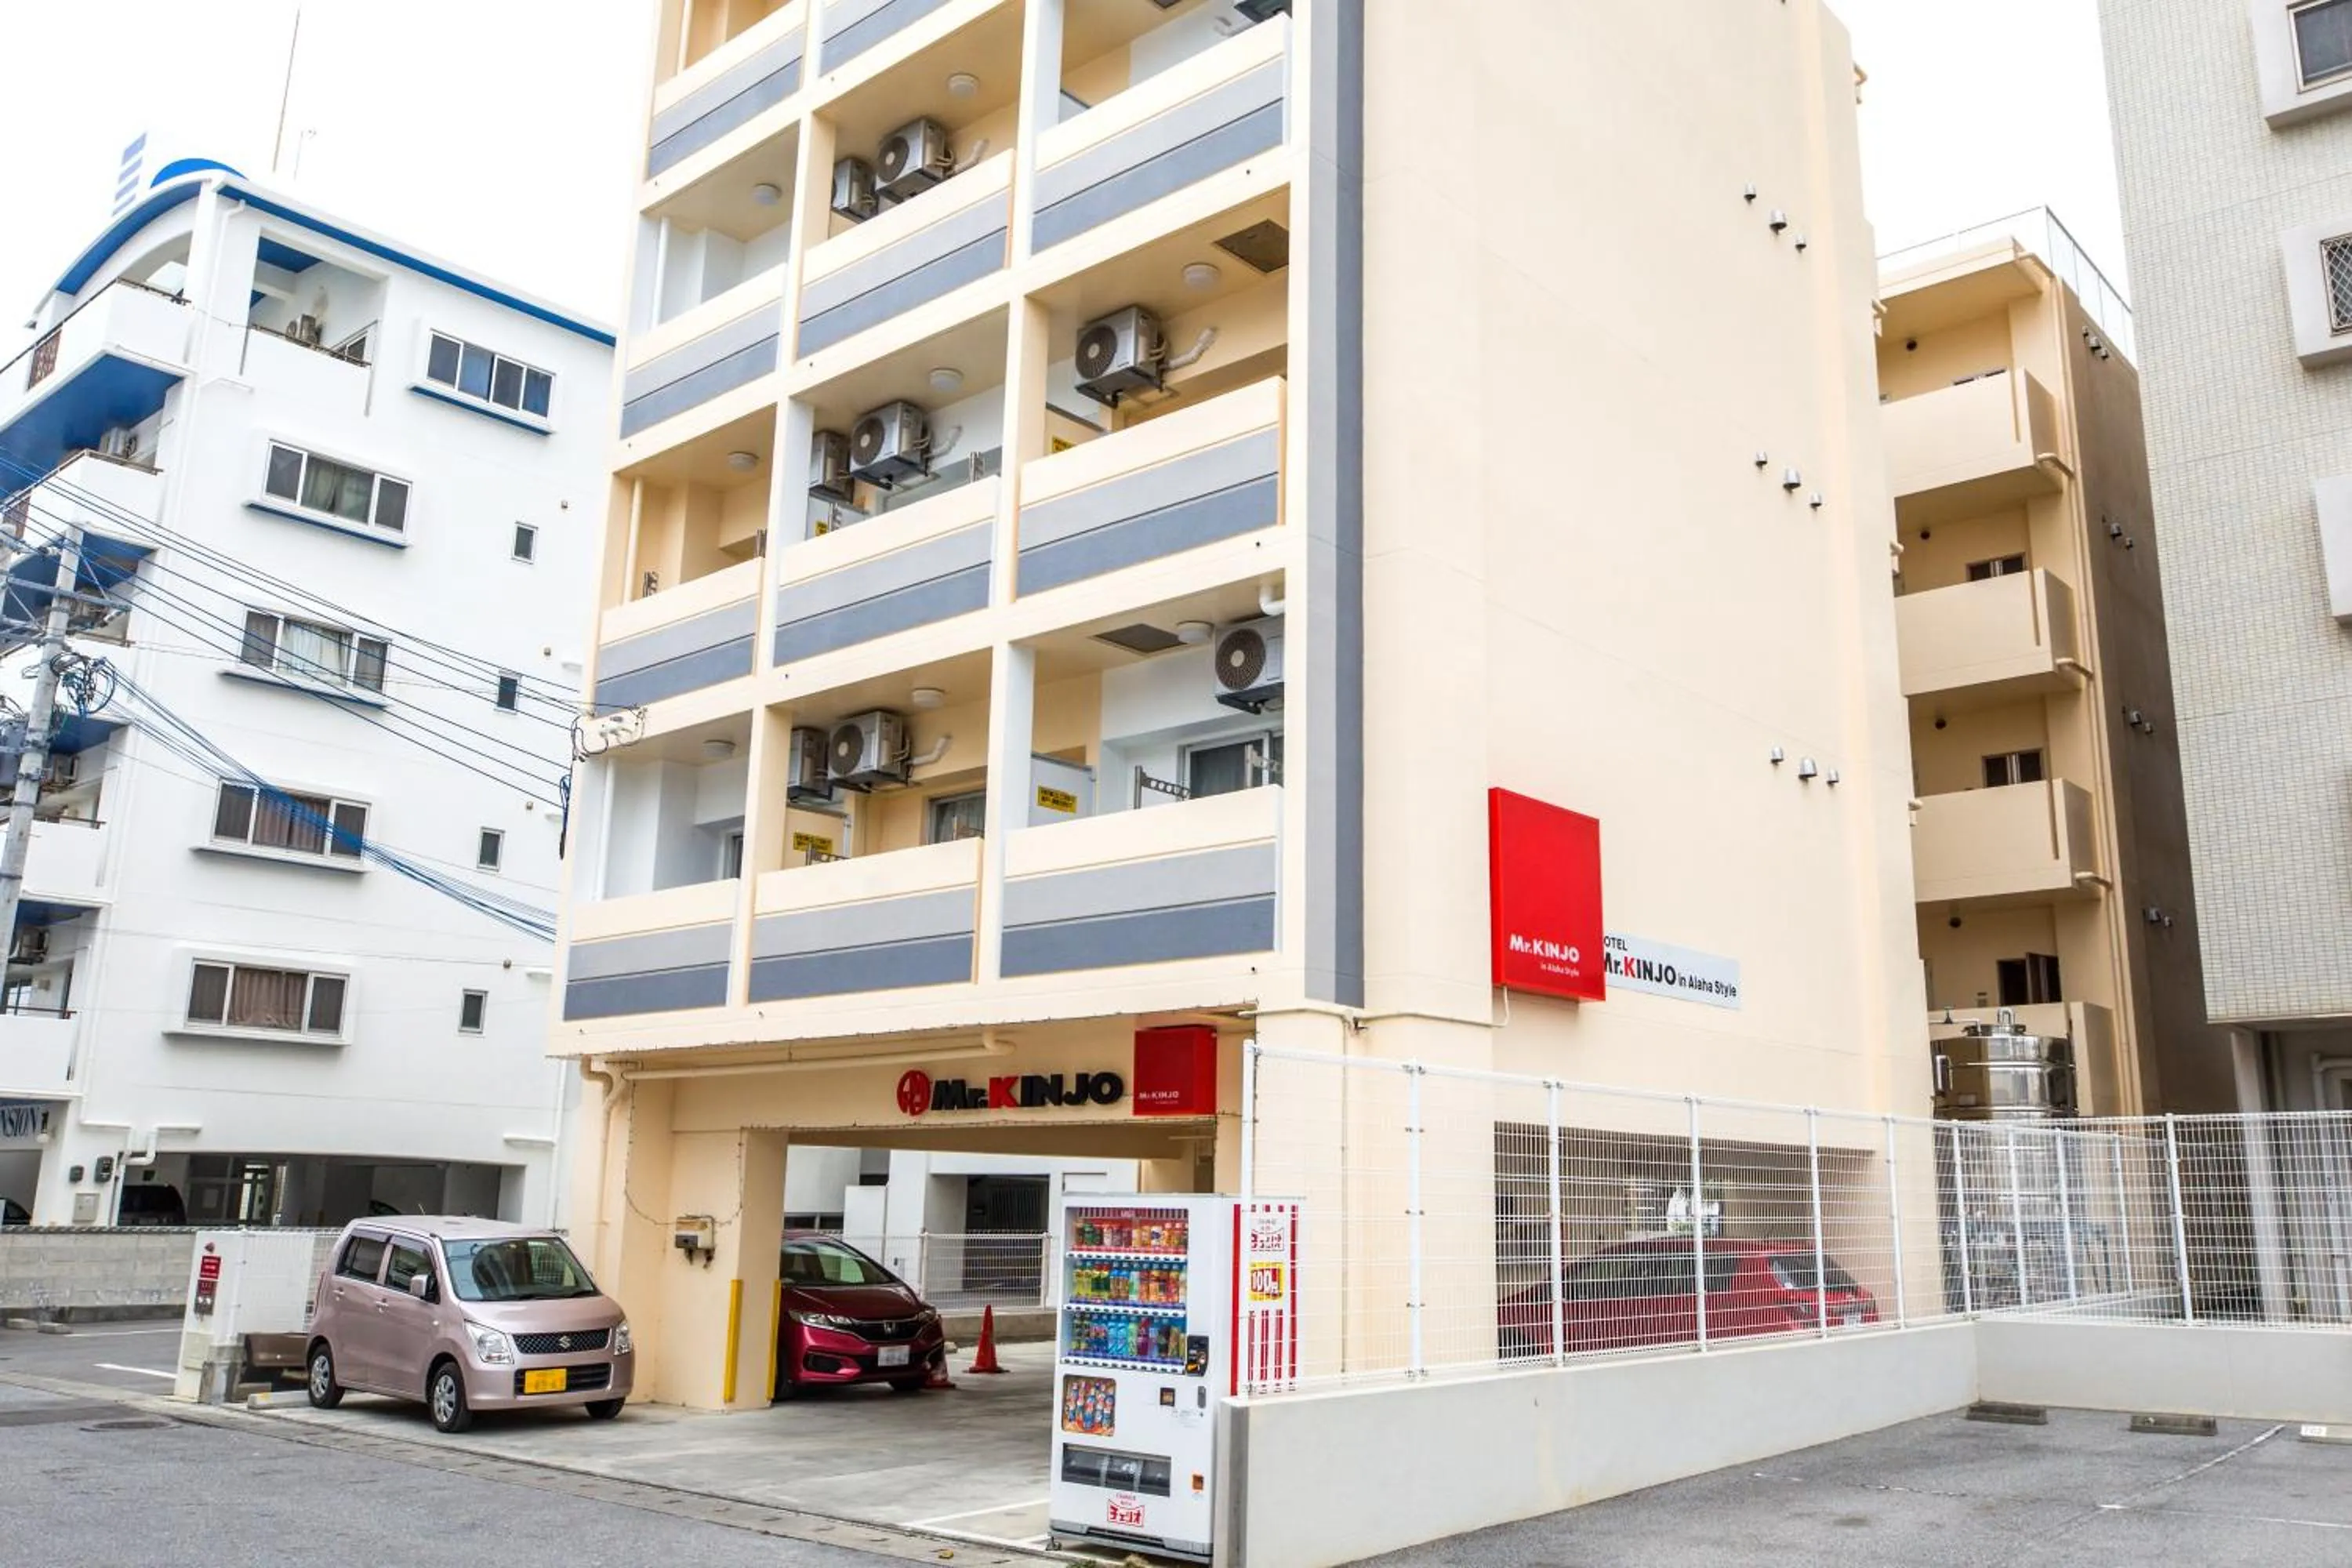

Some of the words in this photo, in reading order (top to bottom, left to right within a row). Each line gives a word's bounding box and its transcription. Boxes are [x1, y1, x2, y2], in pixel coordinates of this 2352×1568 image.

[1509, 933, 1580, 964] Mr.KINJO
[1604, 935, 1628, 951] OTEL
[1715, 981, 1737, 998] Style
[931, 1072, 1123, 1110] Mr.KINJO
